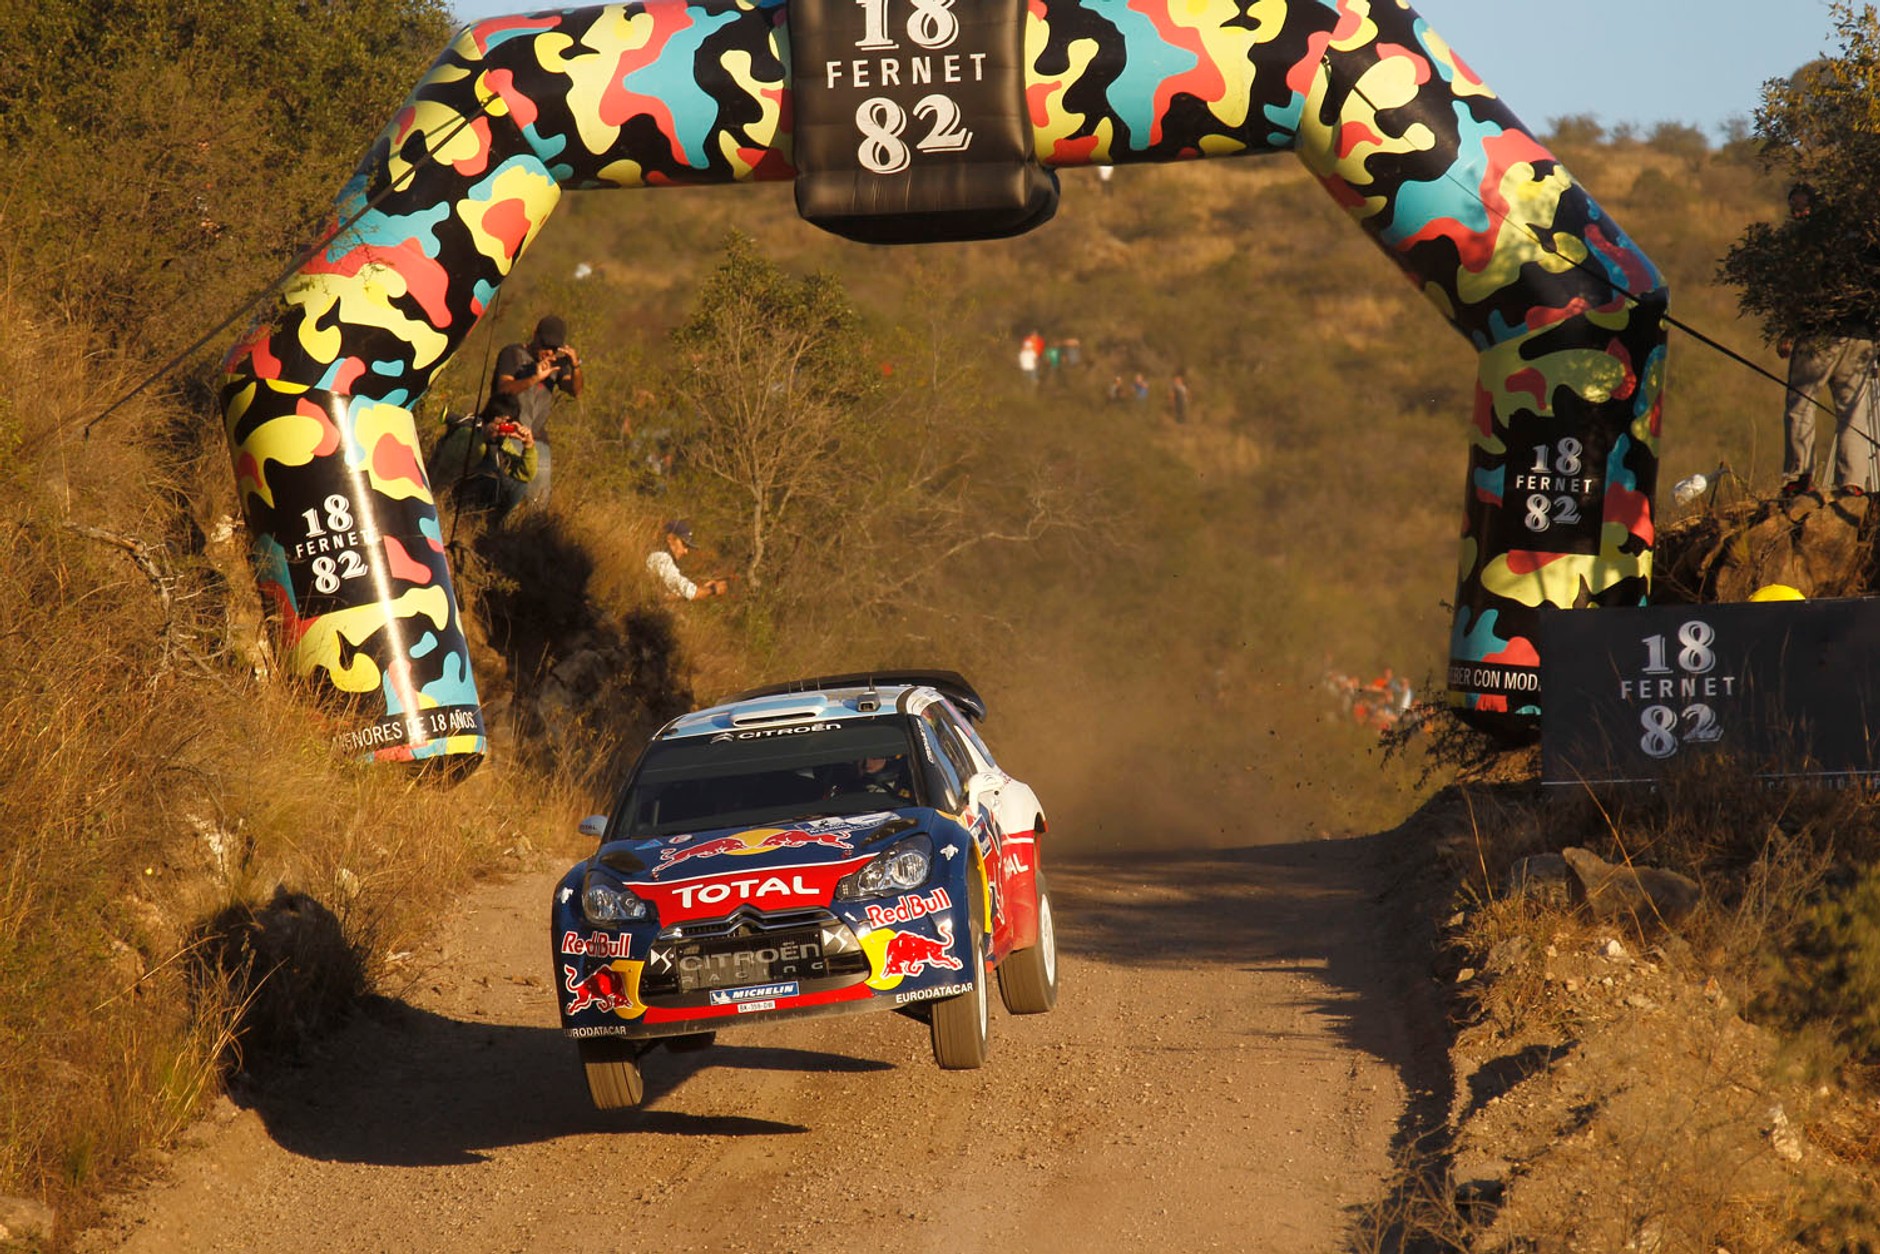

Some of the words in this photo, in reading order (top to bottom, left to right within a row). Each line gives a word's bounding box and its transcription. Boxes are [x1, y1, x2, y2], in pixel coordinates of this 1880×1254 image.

[855, 0, 960, 51] 18
[825, 52, 987, 89] FERNET
[855, 93, 974, 175] 82
[1530, 436, 1584, 477] 18
[1515, 475, 1593, 494] FERNET
[301, 493, 354, 538] 18
[1524, 493, 1582, 533] 82
[295, 530, 380, 559] FERNET
[311, 549, 369, 595] 82
[1640, 619, 1717, 675] 18
[1473, 668, 1501, 689] CON
[1620, 676, 1736, 700] FERNET
[429, 713, 448, 733] 18
[1640, 702, 1725, 760] 82
[671, 875, 820, 909] TOTAL
[865, 895, 910, 930] Red
[907, 886, 953, 920] Bull
[561, 930, 598, 957] Red
[597, 931, 632, 958] Bull
[732, 984, 795, 999] MICHELIN
[895, 982, 974, 1004] EURODATACAR
